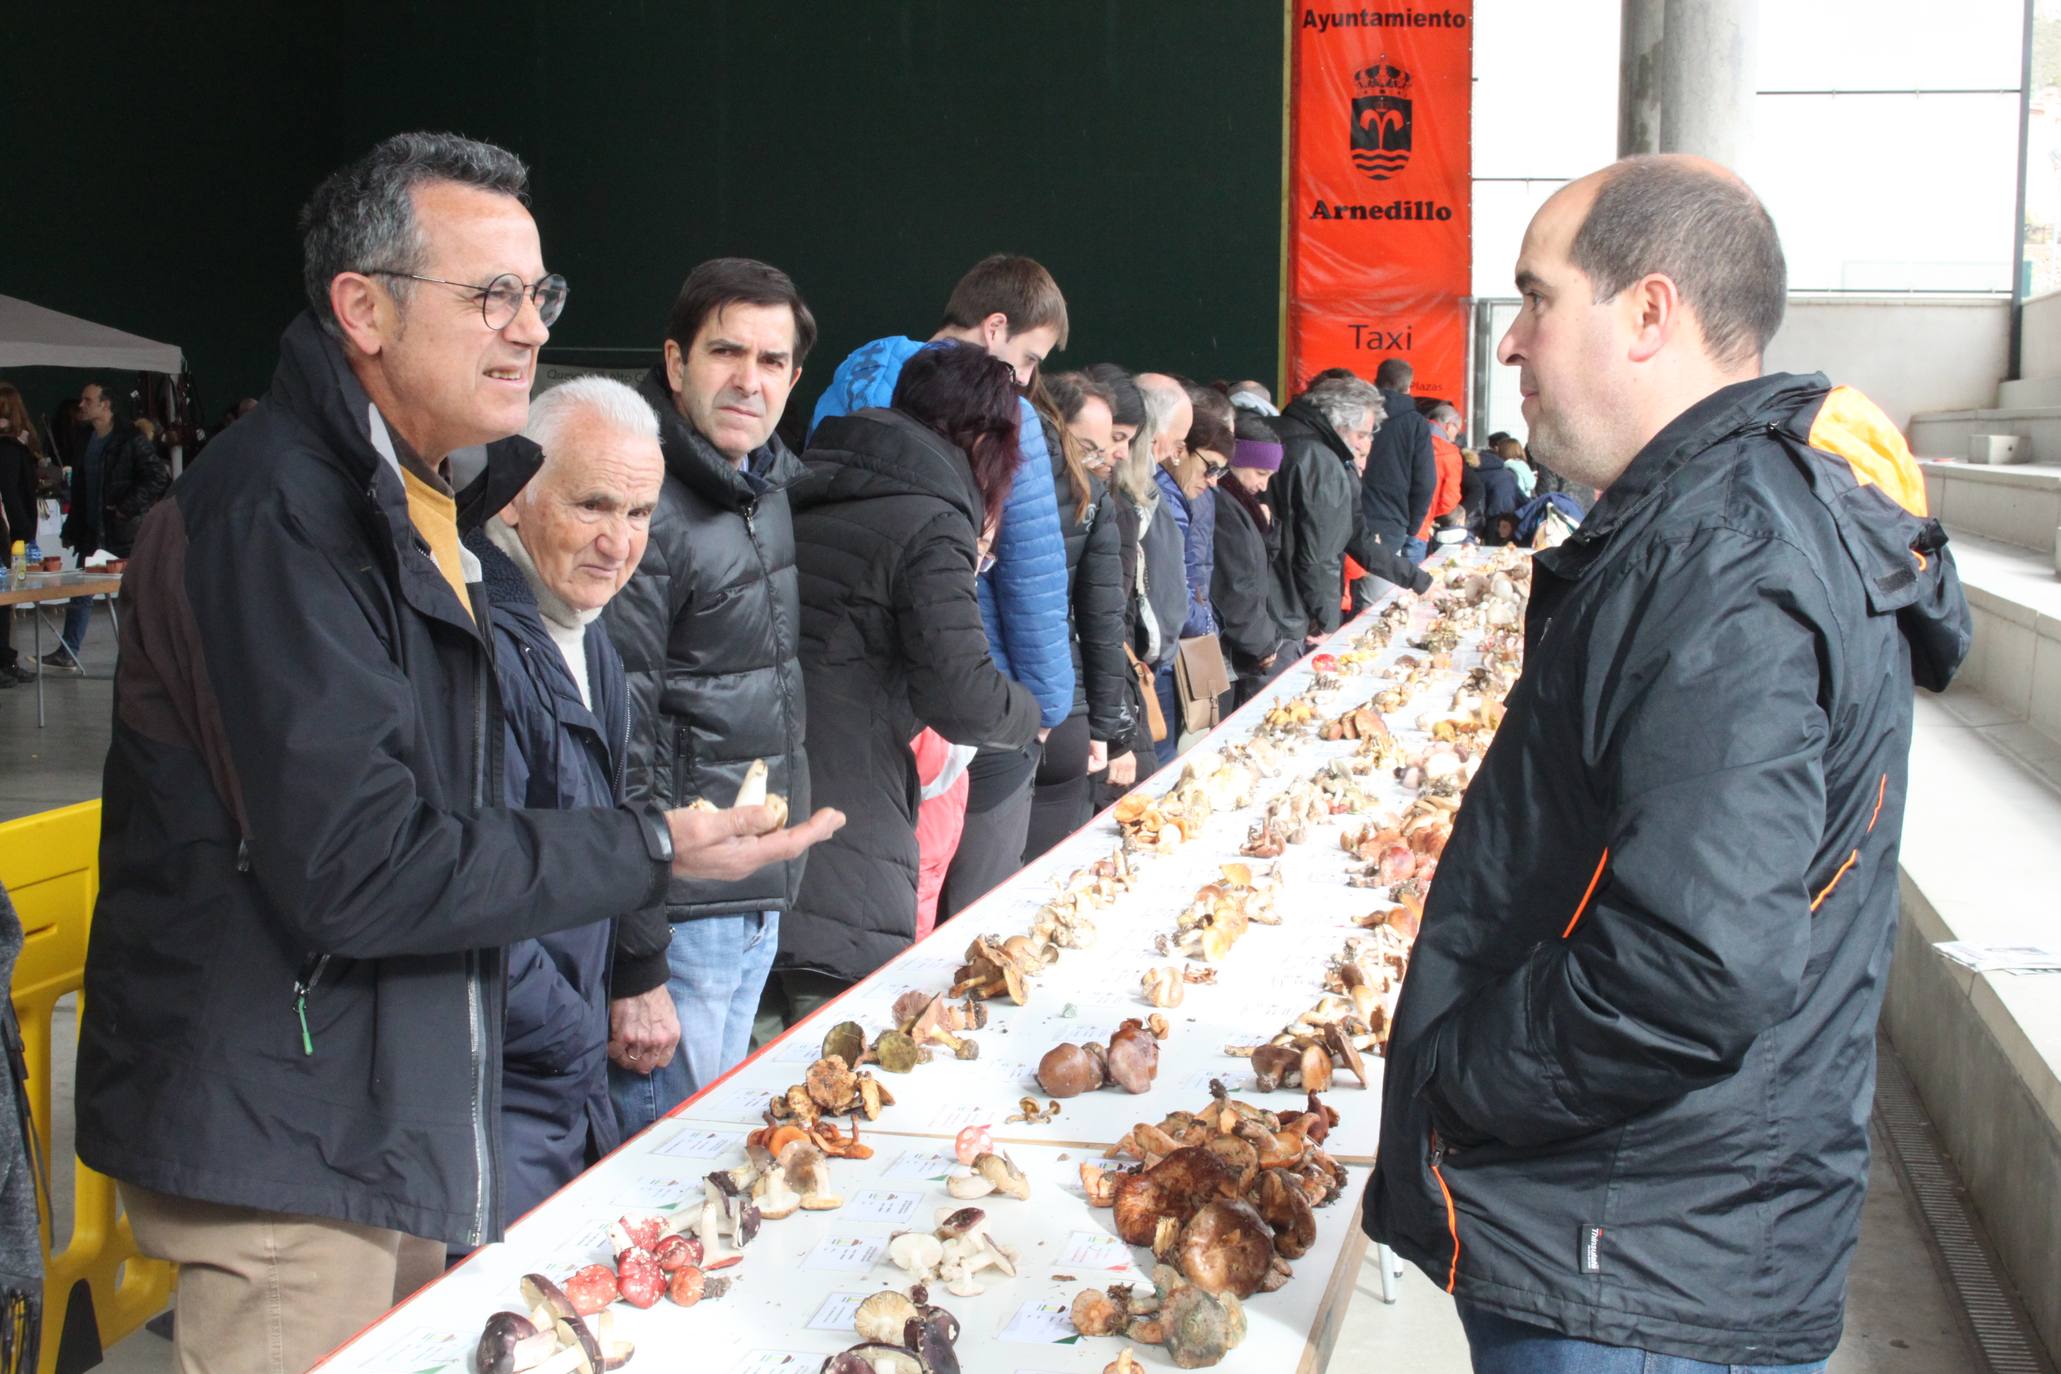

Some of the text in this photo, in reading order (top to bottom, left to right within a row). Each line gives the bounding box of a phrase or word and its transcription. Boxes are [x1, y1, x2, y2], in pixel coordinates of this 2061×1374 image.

[1303, 8, 1466, 32] Ayuntamiento
[1309, 200, 1452, 221] Arnedillo
[1347, 324, 1412, 351] Taxi
